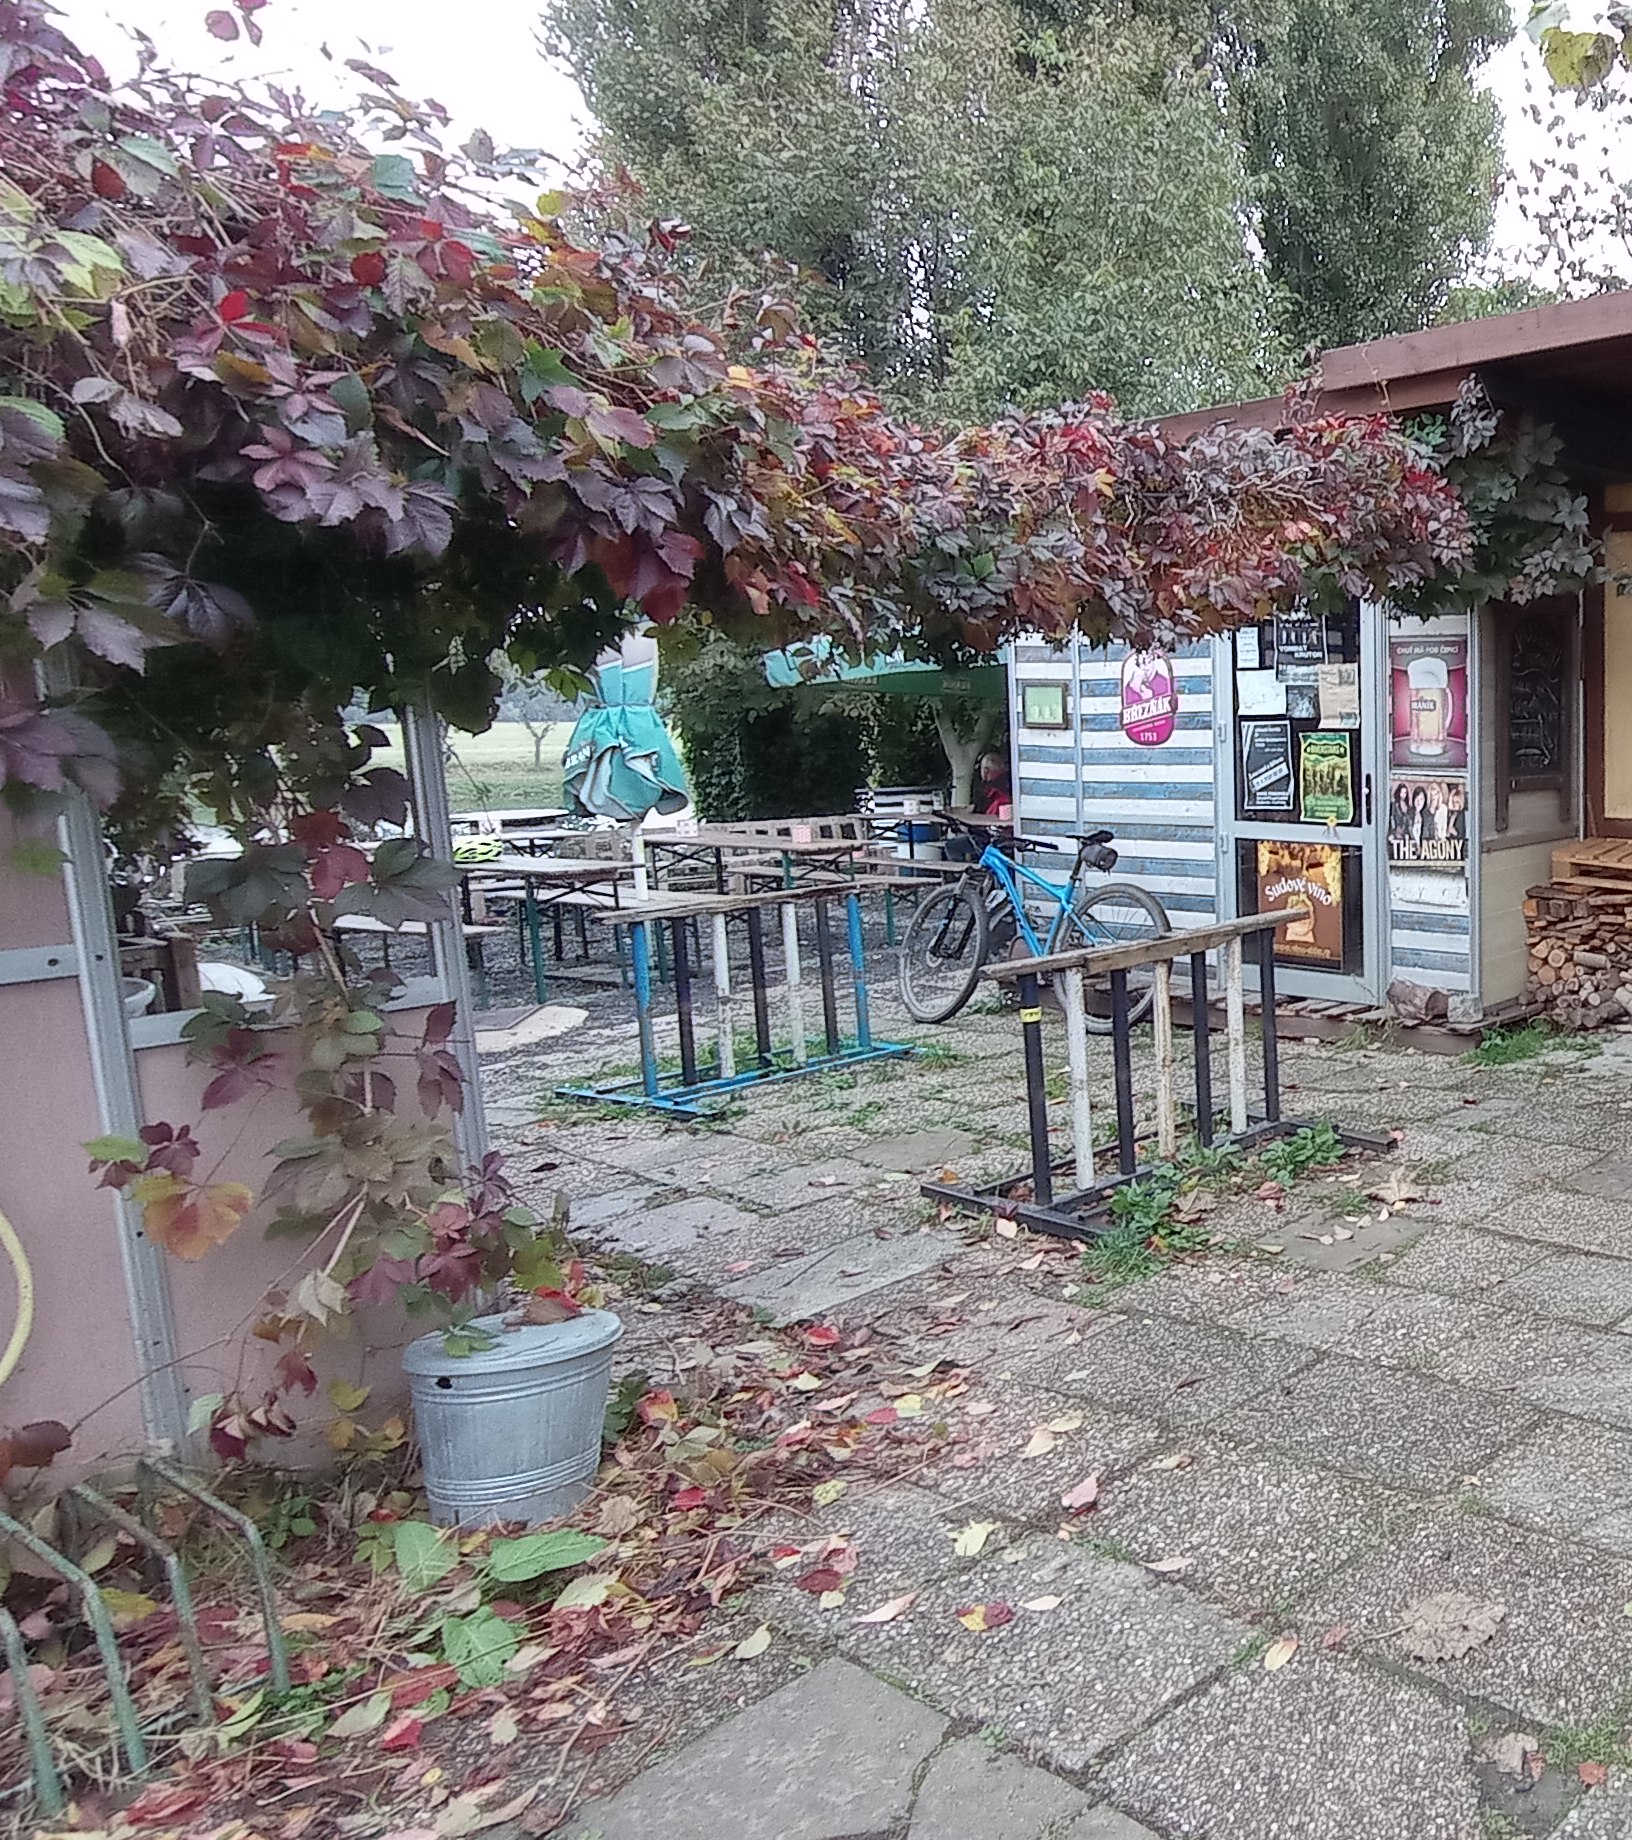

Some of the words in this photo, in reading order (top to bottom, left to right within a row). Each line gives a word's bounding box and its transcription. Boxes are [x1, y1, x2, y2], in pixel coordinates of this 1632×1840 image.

[1122, 695, 1172, 725] BŘEZŇÁK
[1140, 731, 1158, 742] 1753
[1391, 839, 1418, 860] THE
[1421, 839, 1463, 860] AGONY
[1264, 876, 1307, 902] Sudové
